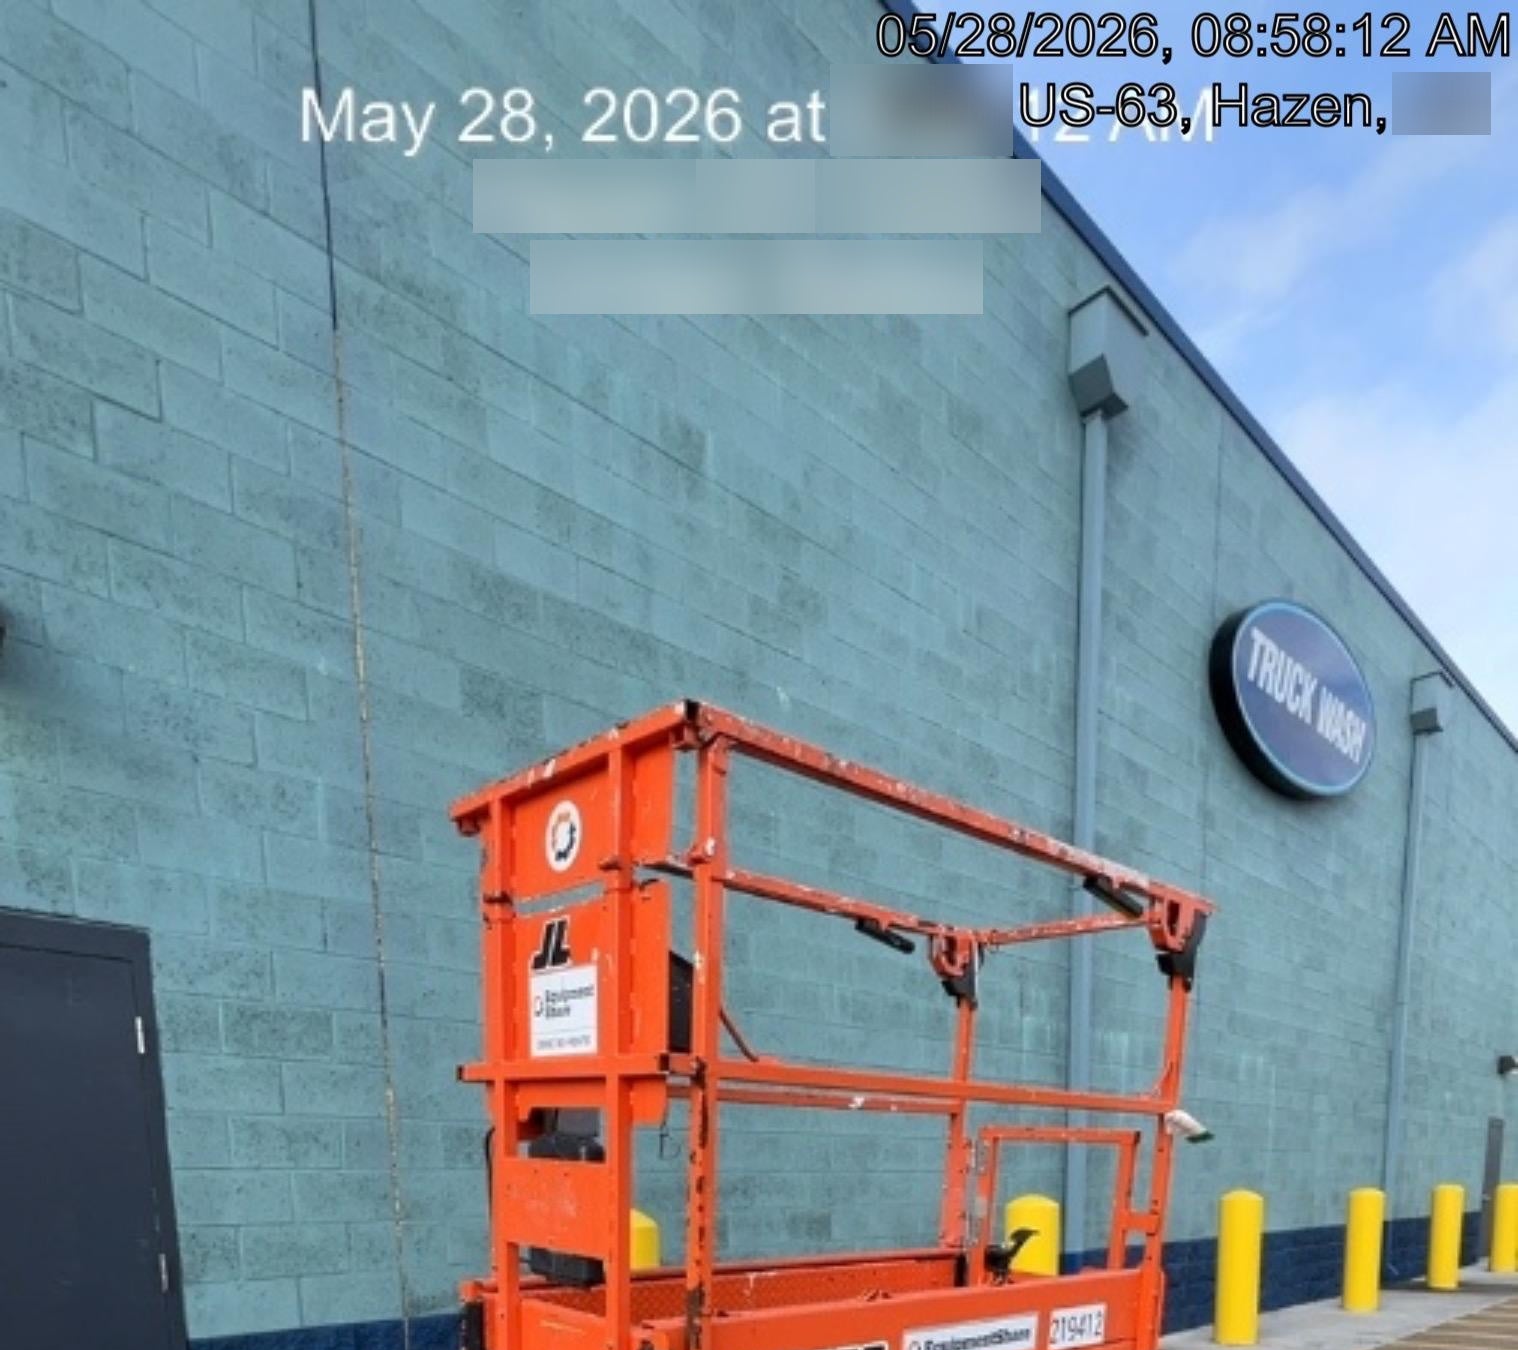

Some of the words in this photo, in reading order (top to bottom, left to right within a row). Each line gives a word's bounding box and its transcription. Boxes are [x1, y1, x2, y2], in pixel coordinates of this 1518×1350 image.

[1246, 627, 1318, 726] TRUCK
[1316, 685, 1368, 766] WASH
[1050, 1310, 1104, 1346] 219412
